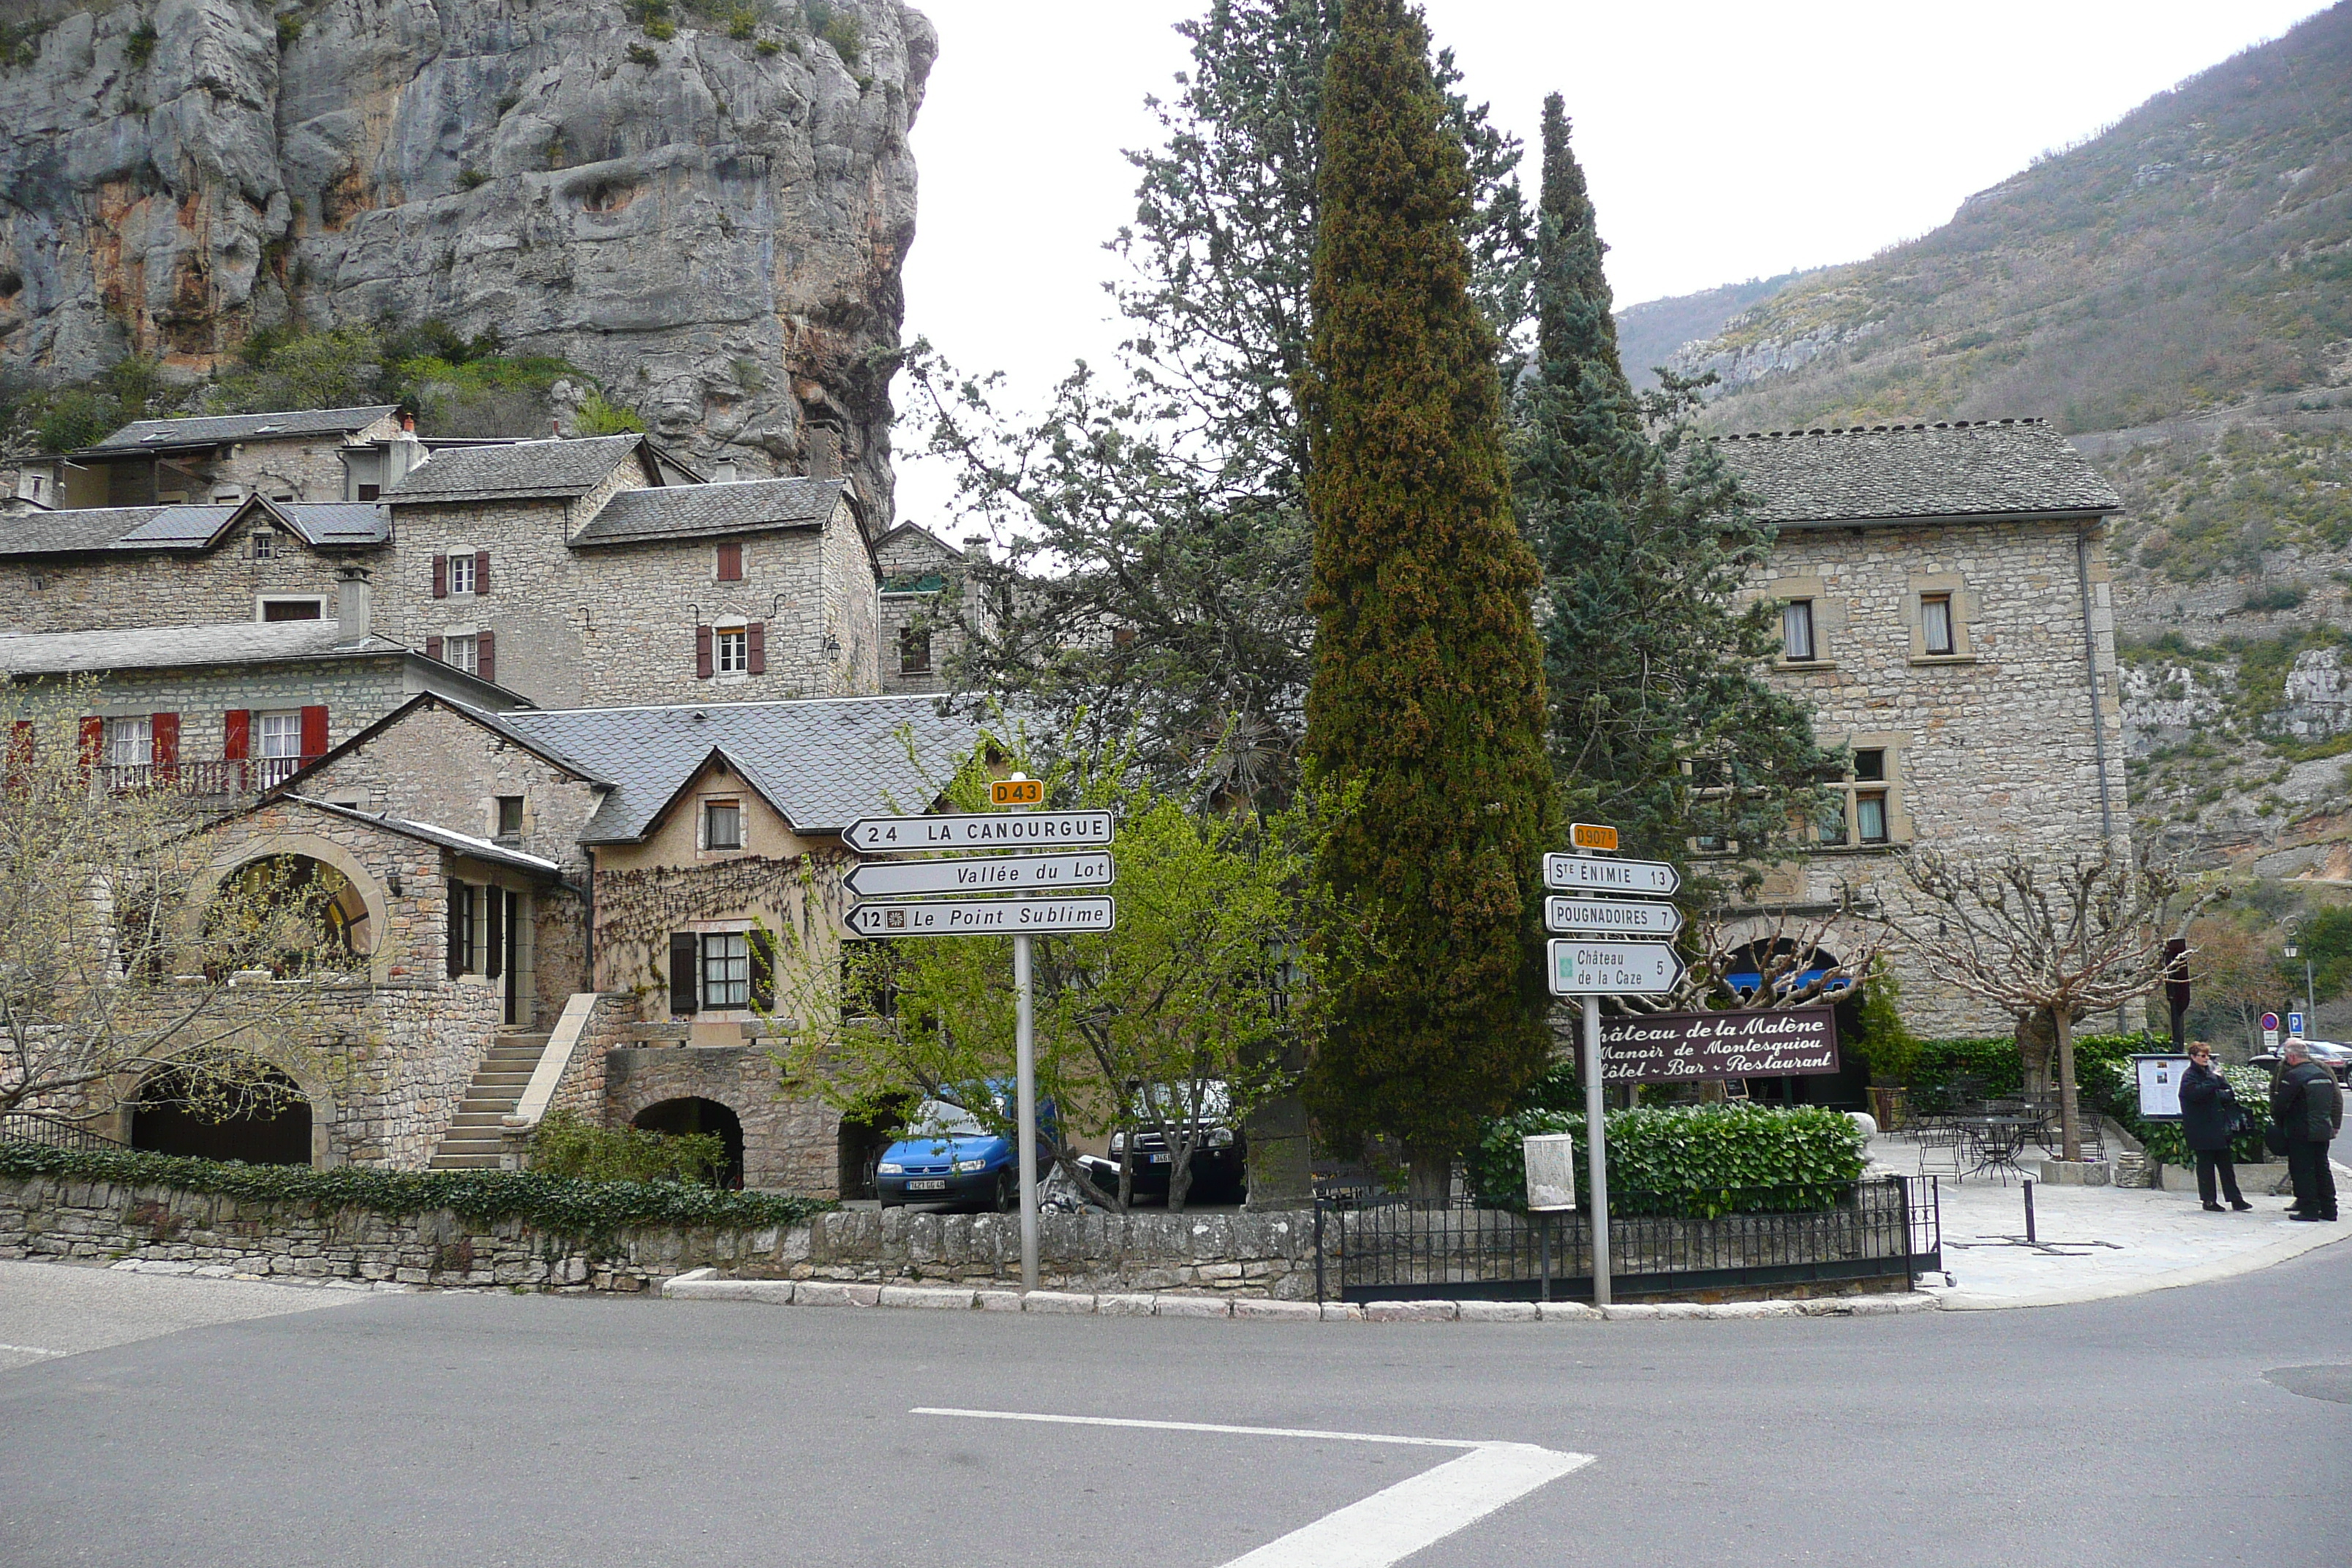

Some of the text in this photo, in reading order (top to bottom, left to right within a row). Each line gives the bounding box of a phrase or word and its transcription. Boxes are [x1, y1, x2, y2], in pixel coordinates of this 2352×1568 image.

[868, 820, 1104, 843] 24 LA CANOURGUE
[957, 862, 1104, 883] Vallée du Lot
[1580, 862, 1631, 883] ÉNIMIE
[1651, 870, 1665, 886] 13
[862, 907, 1104, 927] 12 Le Point Sublime
[1557, 906, 1667, 926] POUGNADOIRES 7
[1578, 949, 1664, 976] Château 5
[1578, 969, 1642, 985] de la Caze
[1599, 1016, 1825, 1043] hâteau de la Malène
[1673, 1041, 1694, 1056] de
[1703, 1036, 1823, 1057] Montesquiou
[1663, 1058, 1707, 1076] Bar
[1726, 1051, 1832, 1072] Restaurant
